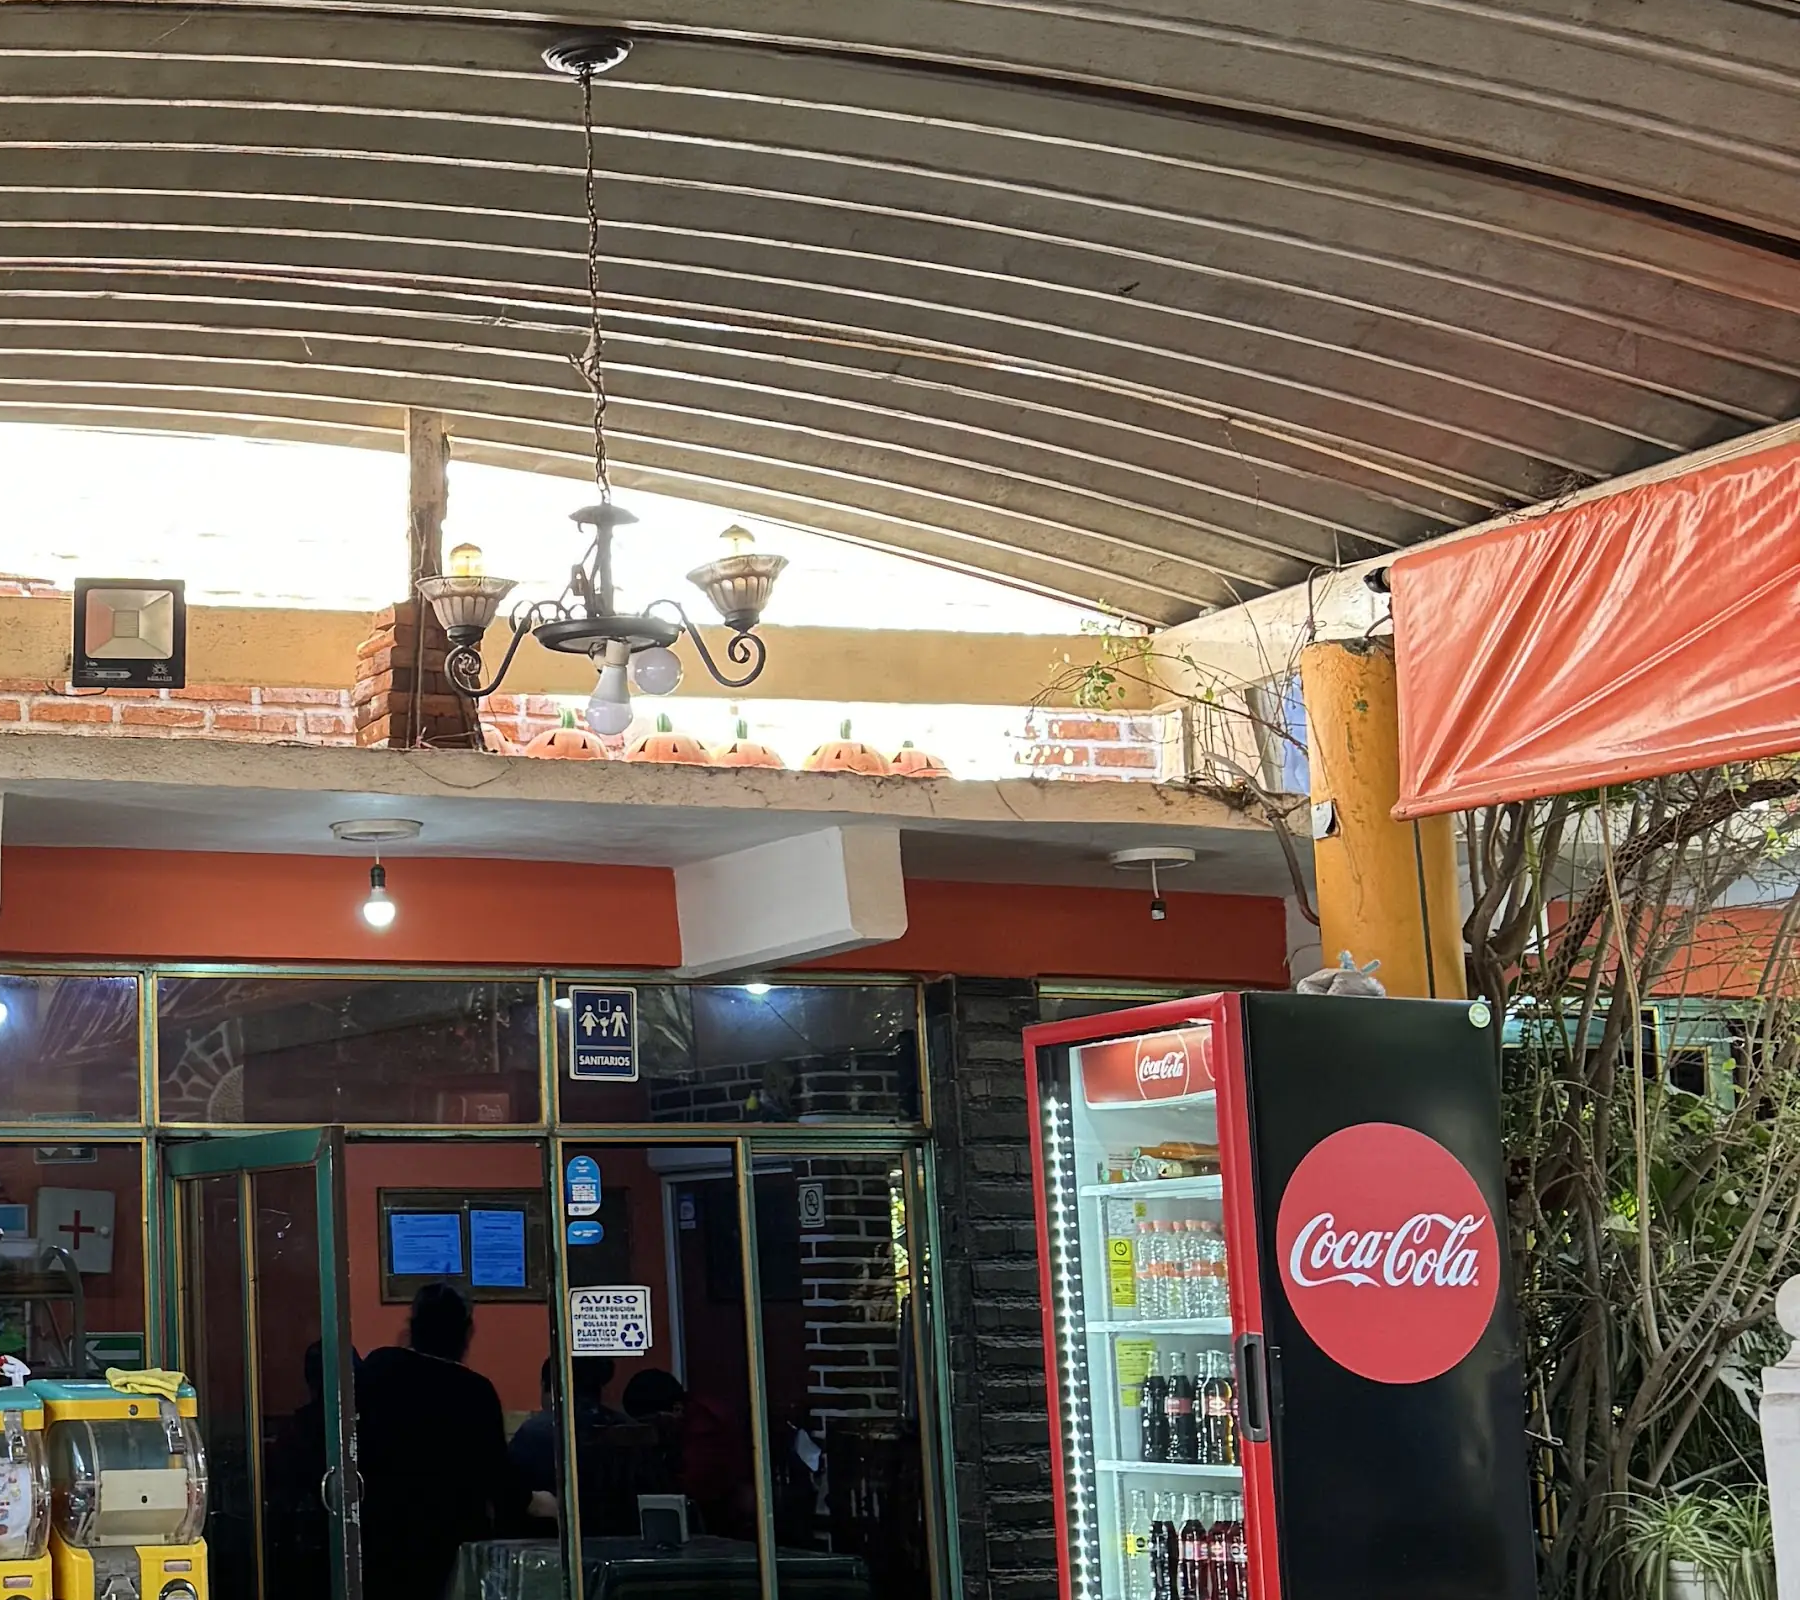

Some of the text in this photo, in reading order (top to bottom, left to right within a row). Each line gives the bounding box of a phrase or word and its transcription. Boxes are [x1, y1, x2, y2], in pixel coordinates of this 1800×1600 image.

[579, 1055, 630, 1066] SANITARIOS
[1139, 1051, 1184, 1082] Coca-Cola
[1289, 1212, 1488, 1288] Coca-Cola
[578, 1295, 638, 1304] AVISO
[577, 1329, 617, 1337] PLASTICO
